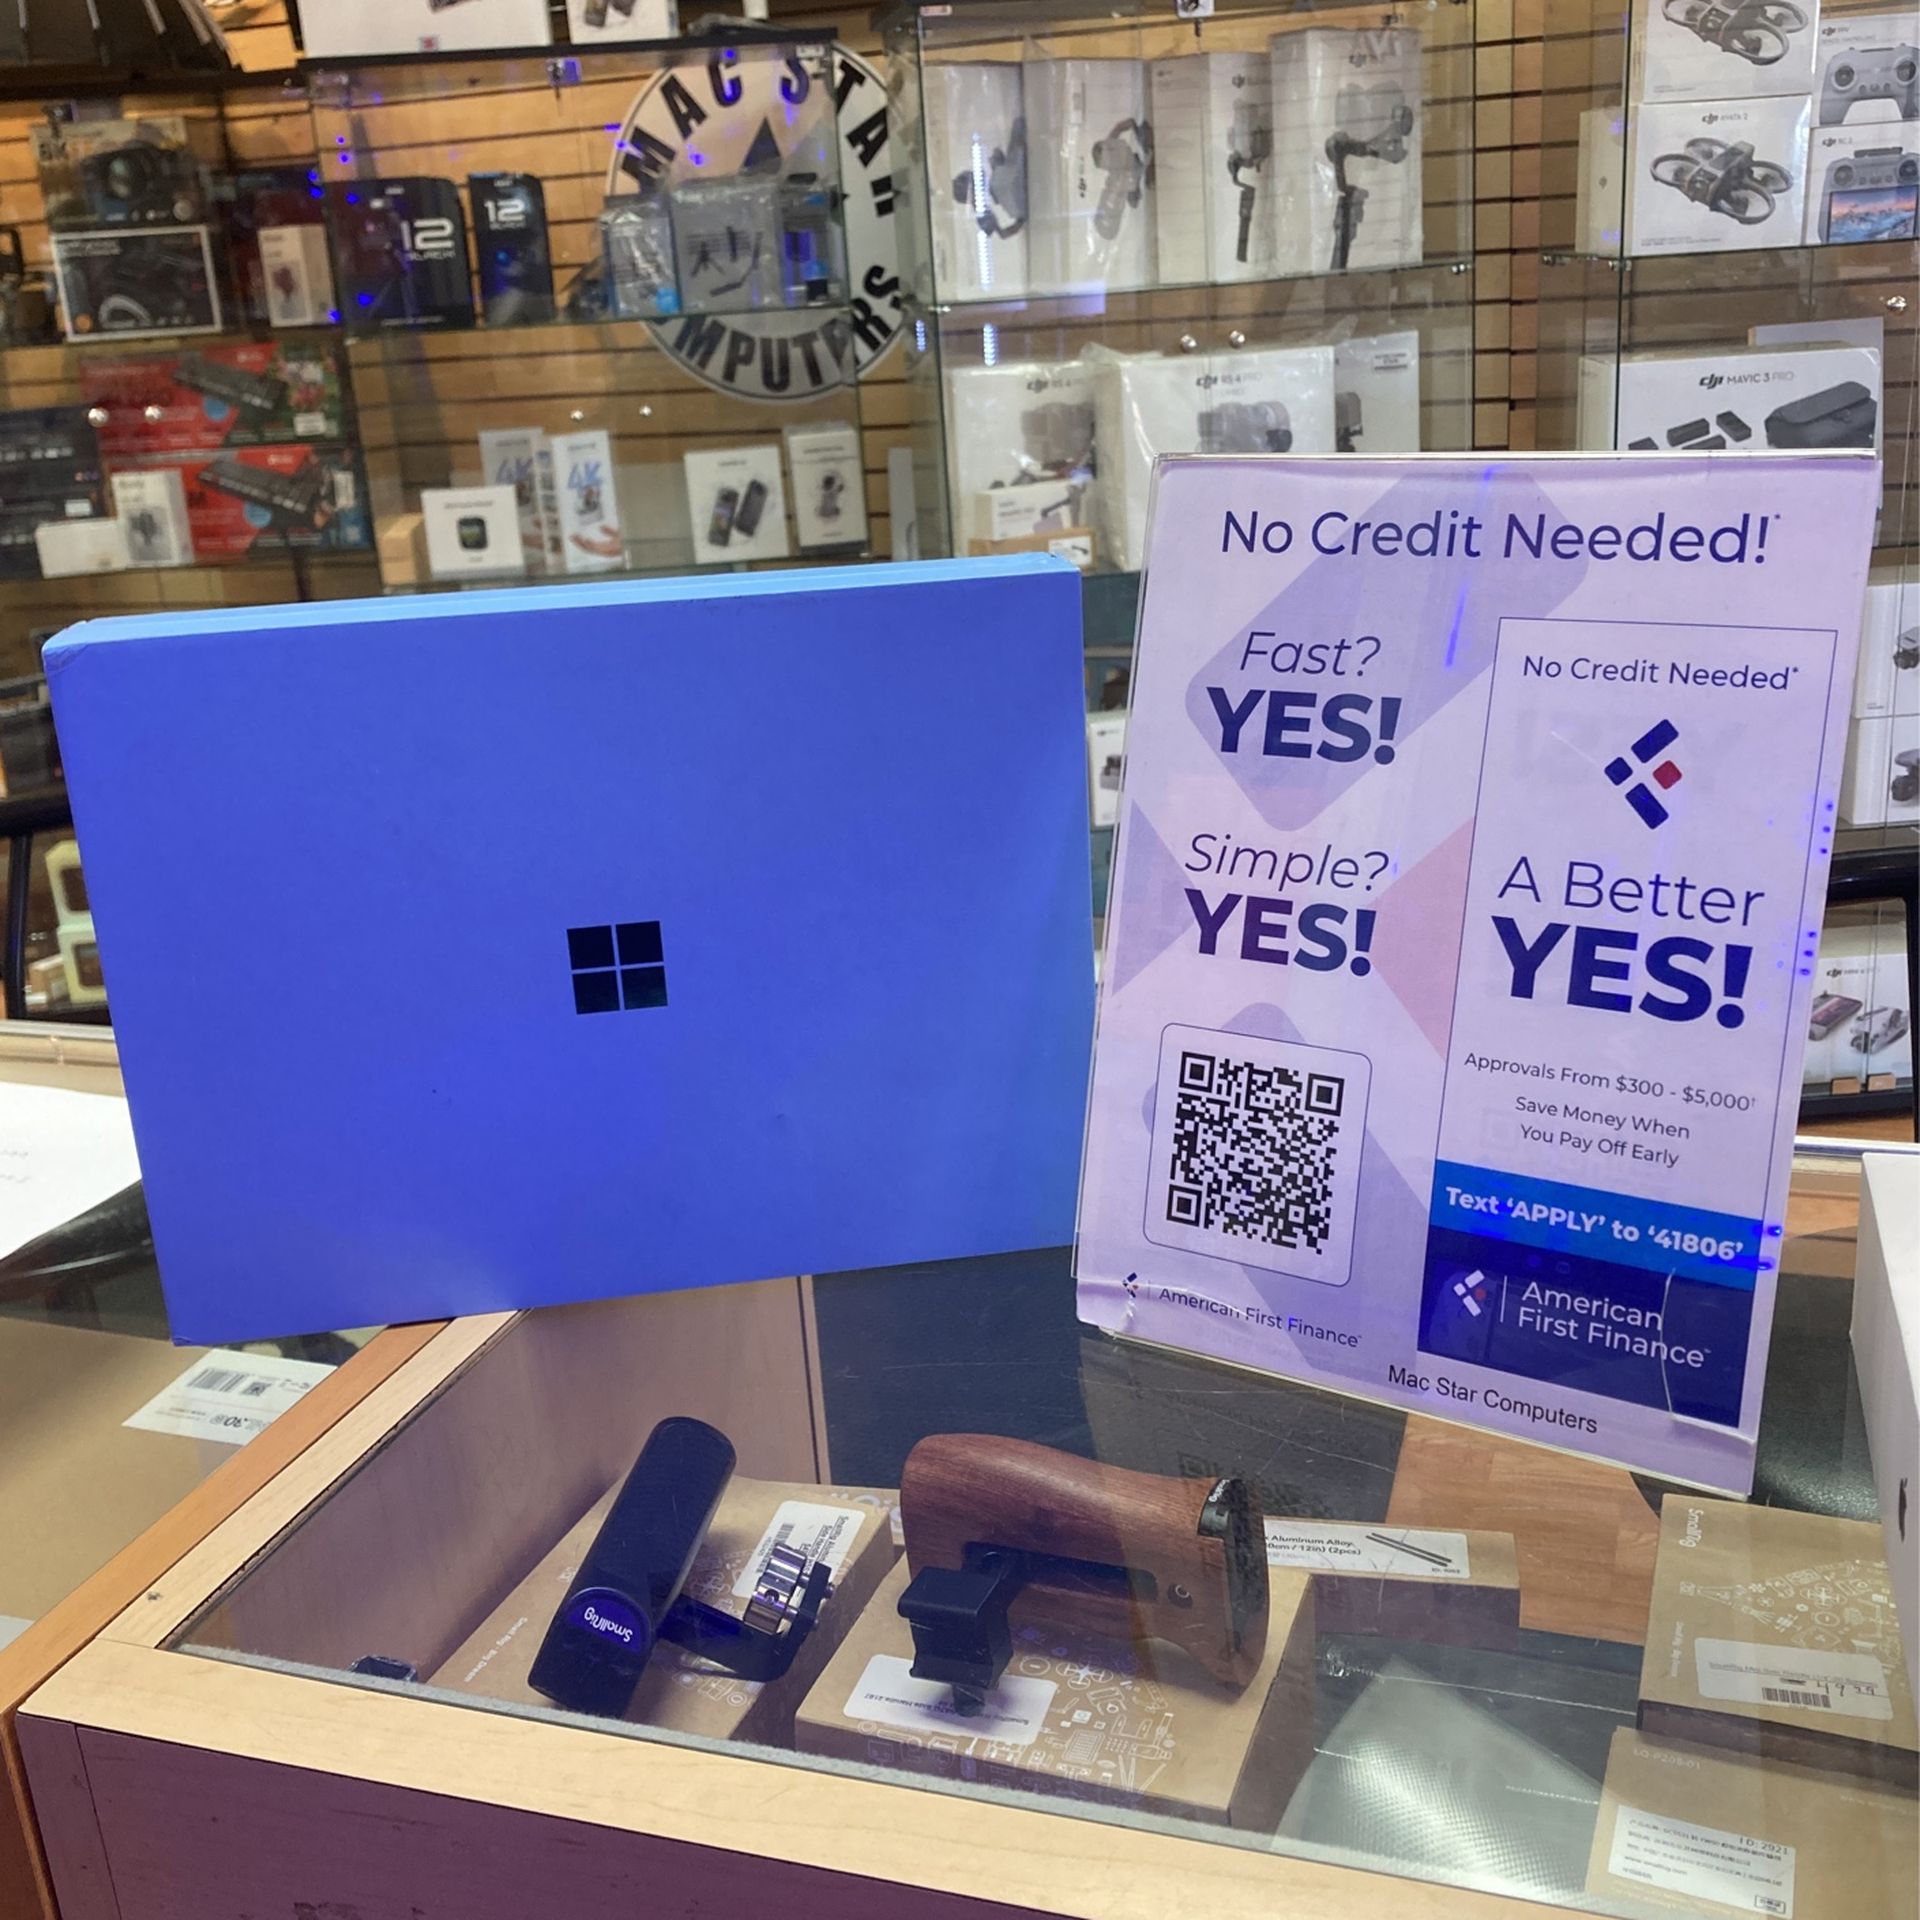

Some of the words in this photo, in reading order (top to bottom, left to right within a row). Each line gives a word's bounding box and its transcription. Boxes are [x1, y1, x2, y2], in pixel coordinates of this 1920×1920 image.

[483, 199, 526, 222] 12
[401, 217, 455, 250] 12
[1727, 373, 1761, 385] MAVIC
[1763, 372, 1770, 383] 3
[1772, 370, 1794, 382] PRO
[1222, 511, 1292, 553] No
[1312, 510, 1482, 557] Credit
[1240, 632, 1380, 676] Fast?
[1524, 656, 1561, 677] No
[1571, 658, 1659, 683] Credit
[1206, 687, 1401, 764] YES!
[1184, 834, 1389, 891] Simple?
[1498, 856, 1541, 902] A
[1565, 863, 1765, 926] Better
[1185, 888, 1376, 976] YES!
[1491, 915, 1753, 1029] YES!
[1464, 1053, 1555, 1079] Approvals
[1561, 1068, 1609, 1088] From
[1616, 1075, 1664, 1097] $300
[1516, 1097, 1557, 1116] Save
[1562, 1105, 1626, 1131] Money
[1633, 1116, 1689, 1139] When
[1521, 1124, 1553, 1143] You
[1560, 1132, 1593, 1153] Pay
[1598, 1139, 1627, 1156] Off
[1632, 1144, 1679, 1168] Early
[1446, 1187, 1499, 1214] Text
[1612, 1221, 1639, 1241] to
[1159, 1288, 1239, 1319] American
[1246, 1308, 1282, 1329] First
[1519, 1308, 1578, 1340] First
[1520, 1281, 1663, 1330] American
[1389, 1365, 1429, 1391] Mac
[1436, 1377, 1477, 1402] Star
[1484, 1388, 1598, 1434] Computers
[1267, 1535, 1325, 1545] Aluminum
[1328, 1547, 1361, 1556] (2pcs)
[584, 1606, 634, 1643] SmallRig
[1761, 1841, 1789, 1856] 2921
